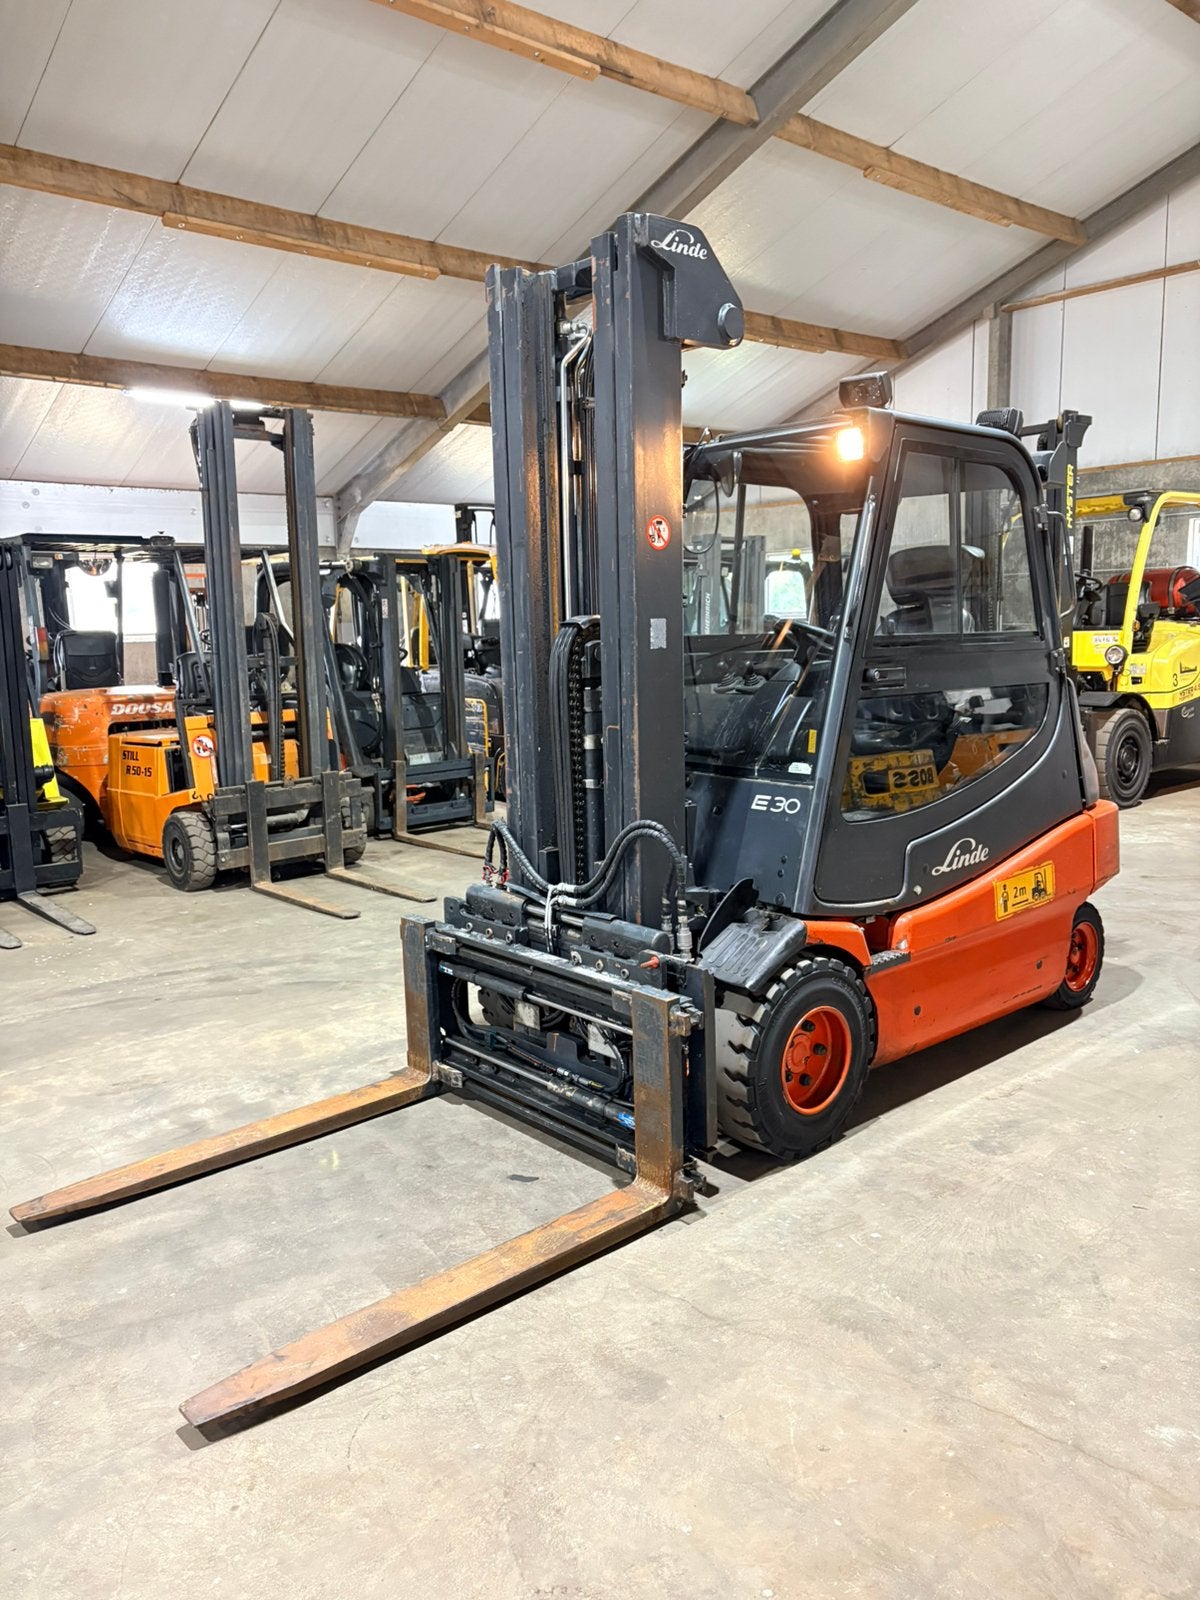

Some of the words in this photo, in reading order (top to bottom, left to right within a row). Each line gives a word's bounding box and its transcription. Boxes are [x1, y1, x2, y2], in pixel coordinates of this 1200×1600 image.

[650, 229, 708, 260] Linde
[1066, 463, 1074, 529] HYSTER
[1172, 673, 1179, 687] 3
[111, 702, 175, 715] DOOSA
[122, 750, 139, 761] STILL
[931, 837, 989, 876] Linde
